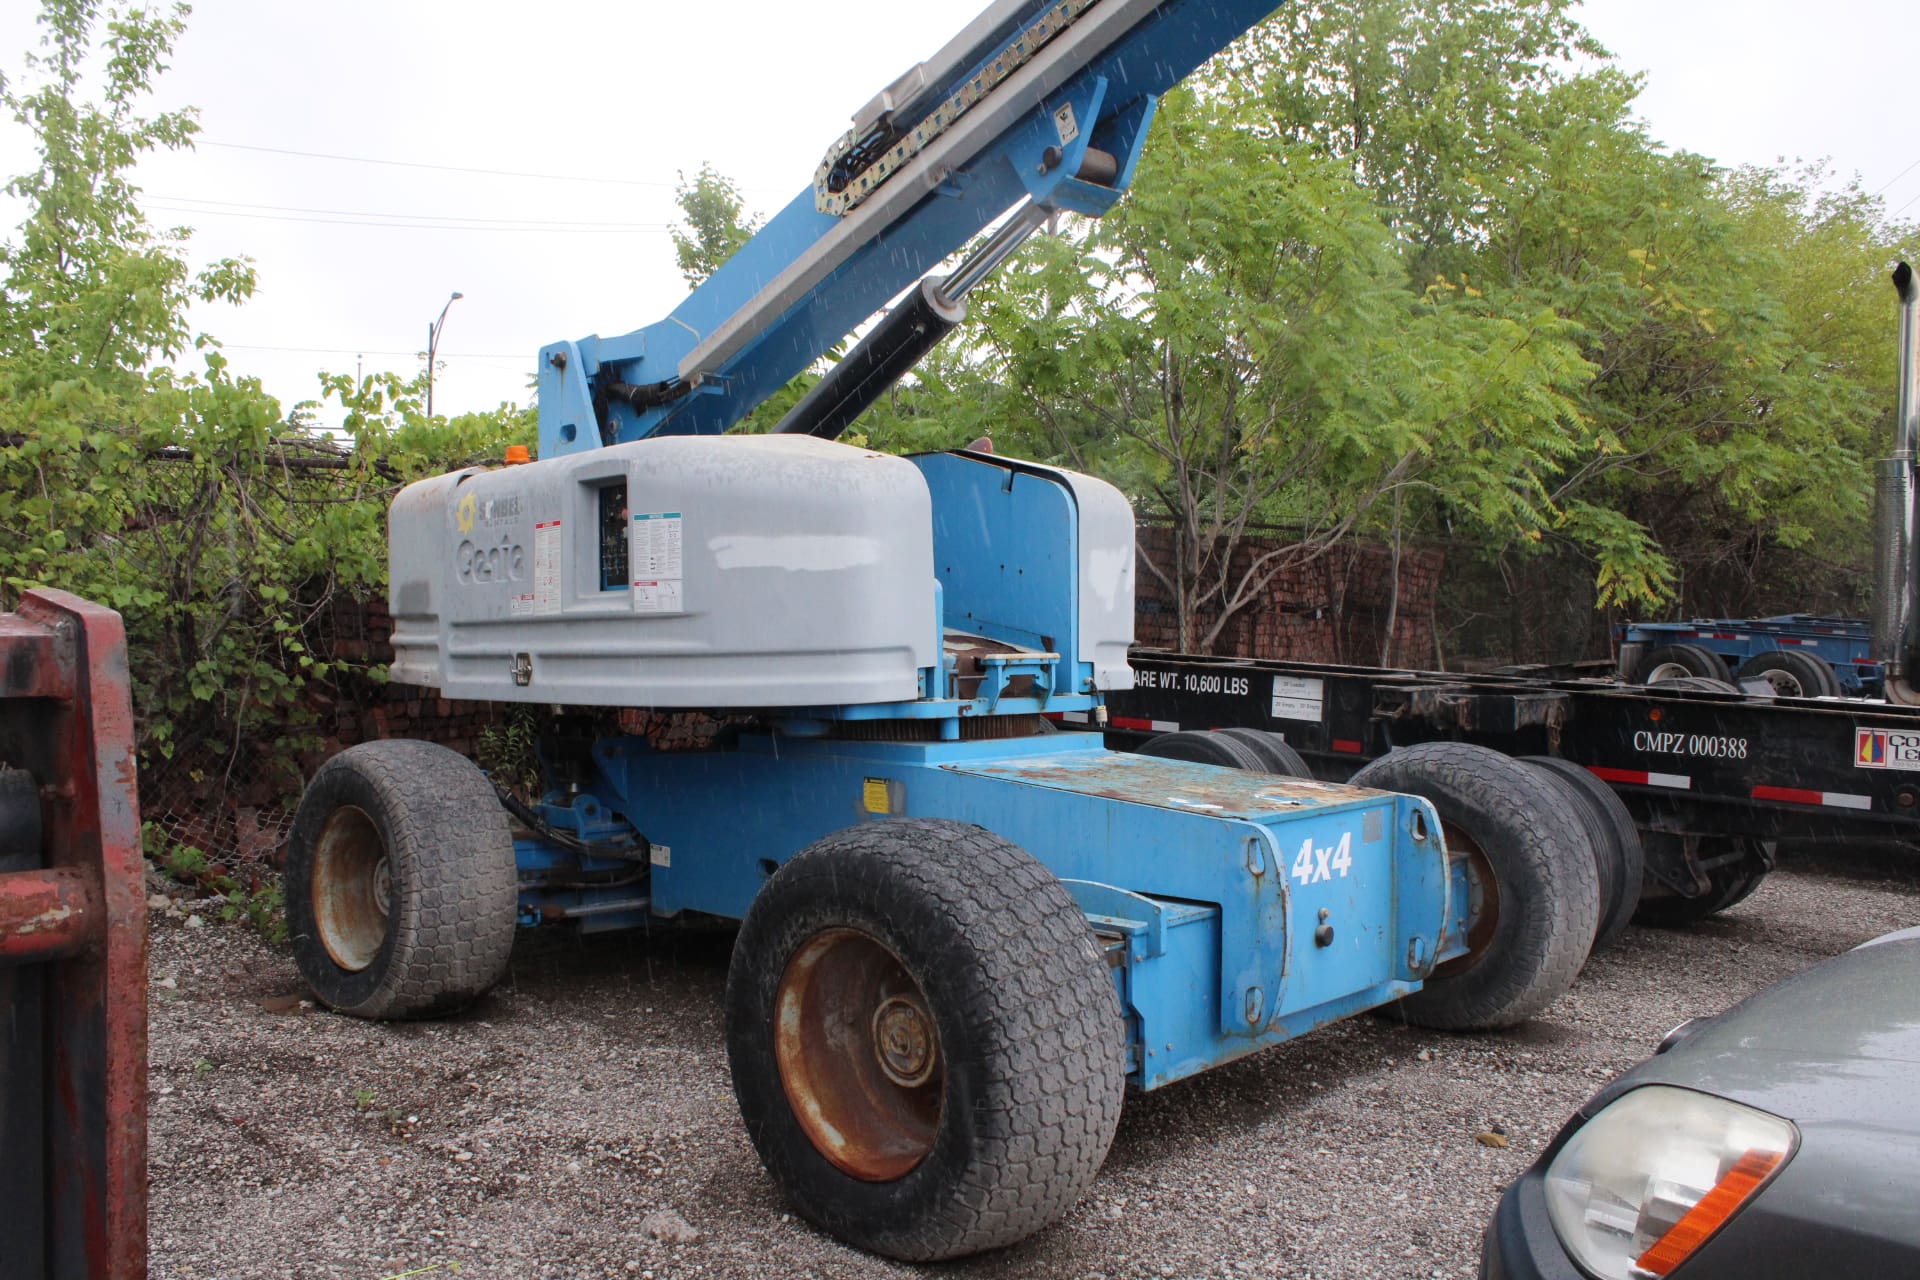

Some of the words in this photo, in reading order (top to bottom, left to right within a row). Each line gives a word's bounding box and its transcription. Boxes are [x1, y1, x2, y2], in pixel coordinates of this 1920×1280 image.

[1133, 670, 1157, 687] ARE
[1159, 671, 1181, 690] WT.
[1184, 674, 1221, 694] 10,600
[1223, 676, 1249, 696] LBS
[1633, 730, 1686, 754] CMPZ
[1689, 734, 1748, 759] 000388
[1291, 831, 1352, 886] 4x4
